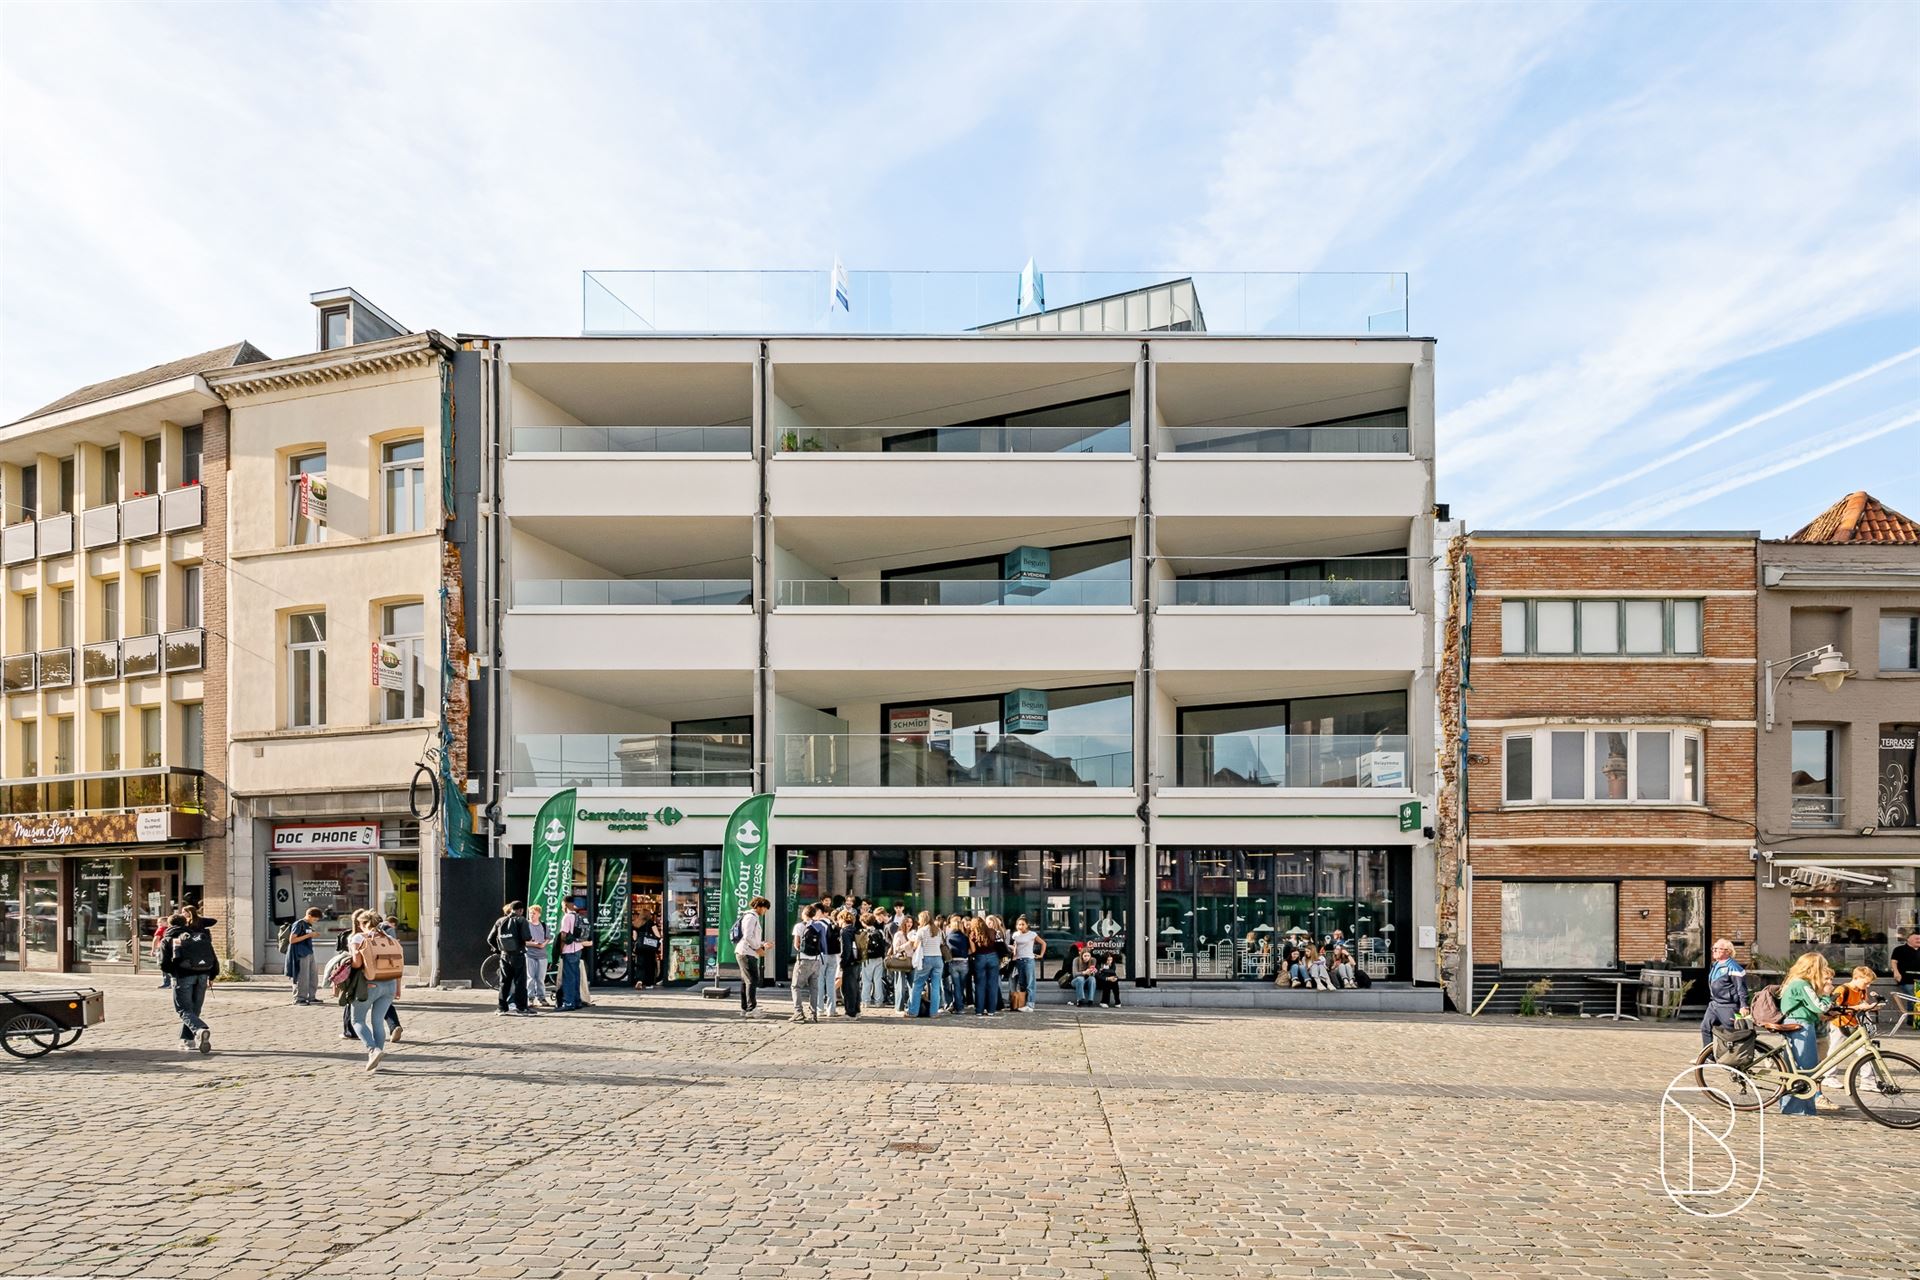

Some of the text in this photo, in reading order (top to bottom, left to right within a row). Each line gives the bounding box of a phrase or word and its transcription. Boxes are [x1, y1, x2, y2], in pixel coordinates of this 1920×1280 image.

[1881, 738, 1915, 746] TERRASSE
[577, 808, 649, 821] Carrefour
[14, 821, 46, 838] Maison
[608, 823, 648, 832] express
[277, 831, 358, 844] DOC PHONE
[561, 859, 571, 897] xpress
[752, 863, 764, 898] press
[1087, 940, 1125, 948] Carrefour
